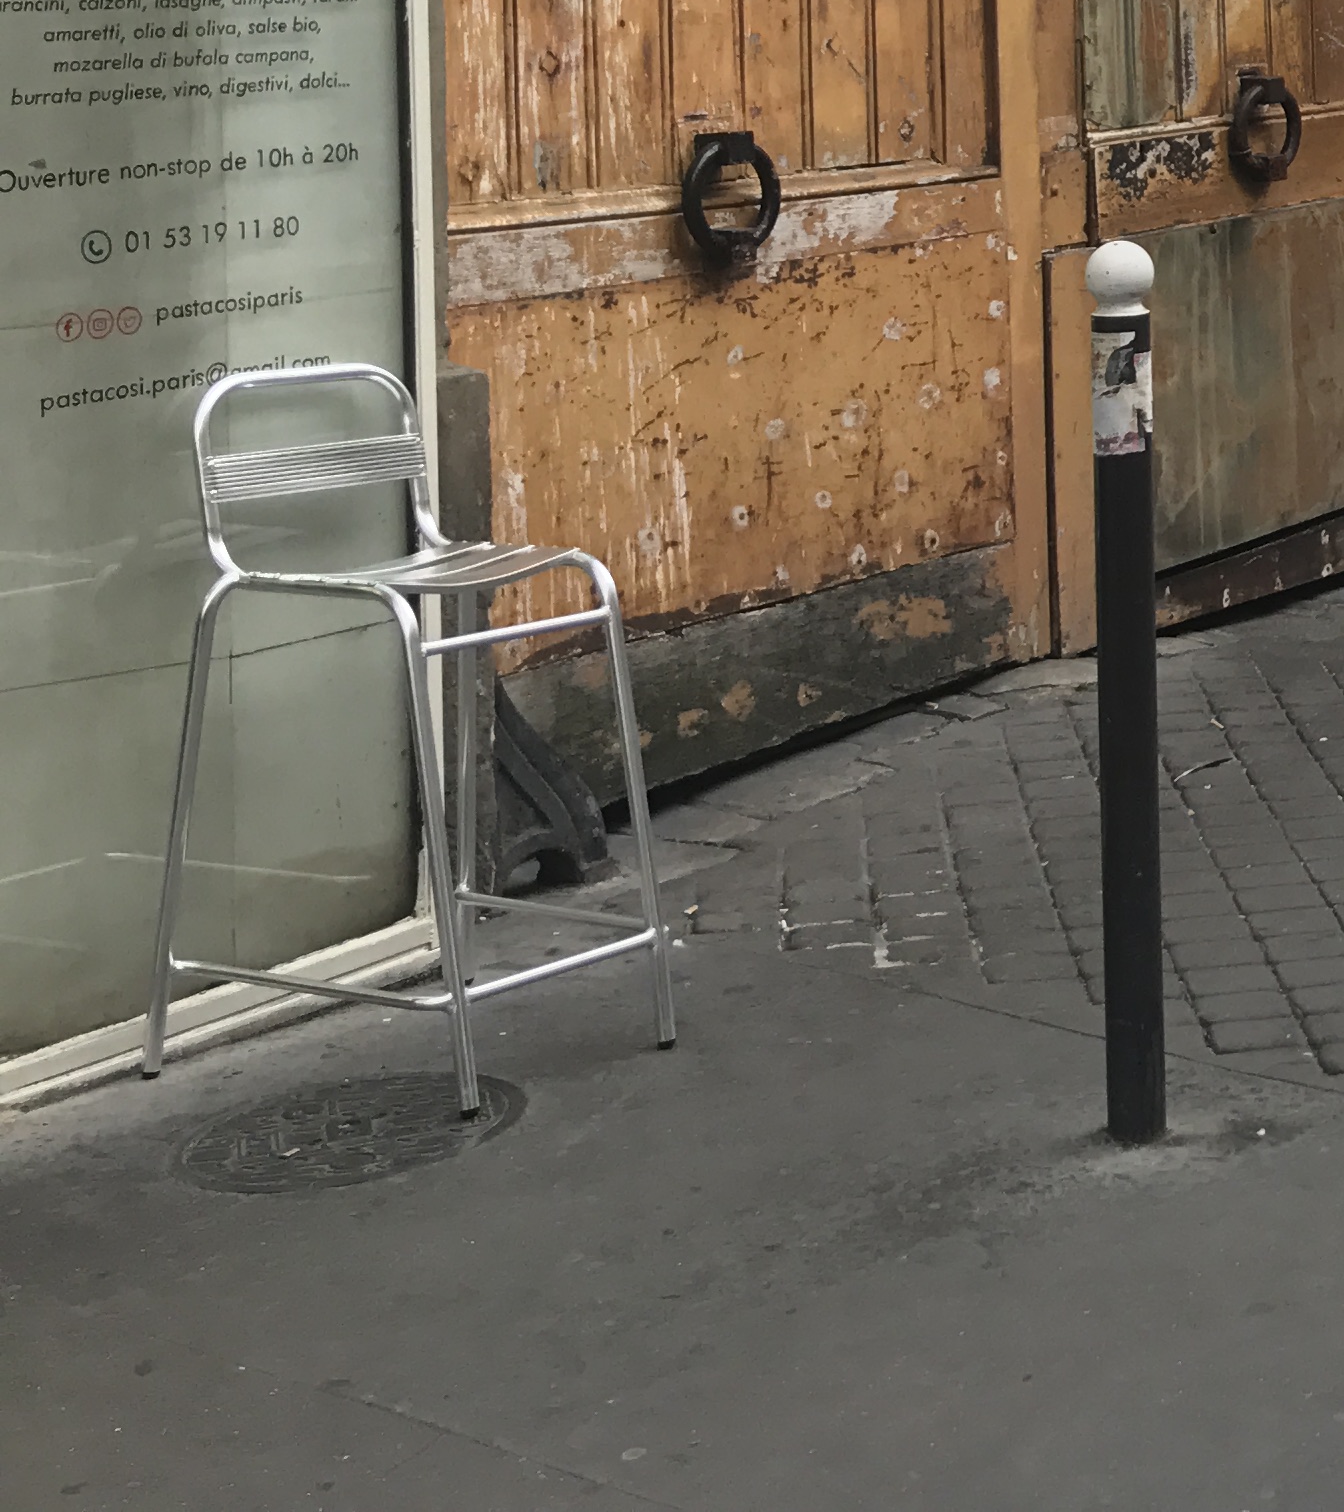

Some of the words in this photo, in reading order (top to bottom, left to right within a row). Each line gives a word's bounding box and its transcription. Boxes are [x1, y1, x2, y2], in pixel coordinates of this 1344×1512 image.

[43, 23, 126, 44] amaretti,
[133, 22, 165, 40] olio
[172, 20, 188, 38] di
[196, 19, 242, 38] oliva,
[248, 18, 287, 35] salse
[292, 16, 322, 35] bio,
[53, 50, 143, 73] mozarella
[151, 49, 167, 69] di
[173, 46, 229, 68] bufala
[235, 48, 314, 66] campana,
[11, 86, 82, 106] burrata
[89, 82, 167, 106] pugliese,
[173, 79, 213, 100] vino,
[219, 75, 294, 96] digestivi,
[0, 166, 110, 193] Ouverture
[120, 158, 211, 180] non-stop
[220, 151, 247, 172] de
[256, 146, 293, 169] 10h
[302, 146, 314, 165] à
[322, 142, 359, 163] 20h
[125, 230, 151, 253] 01
[163, 225, 192, 249] 53
[202, 221, 227, 244] 19
[238, 219, 261, 239] 11
[273, 215, 300, 238] 80
[155, 286, 304, 325] pastacosiparis
